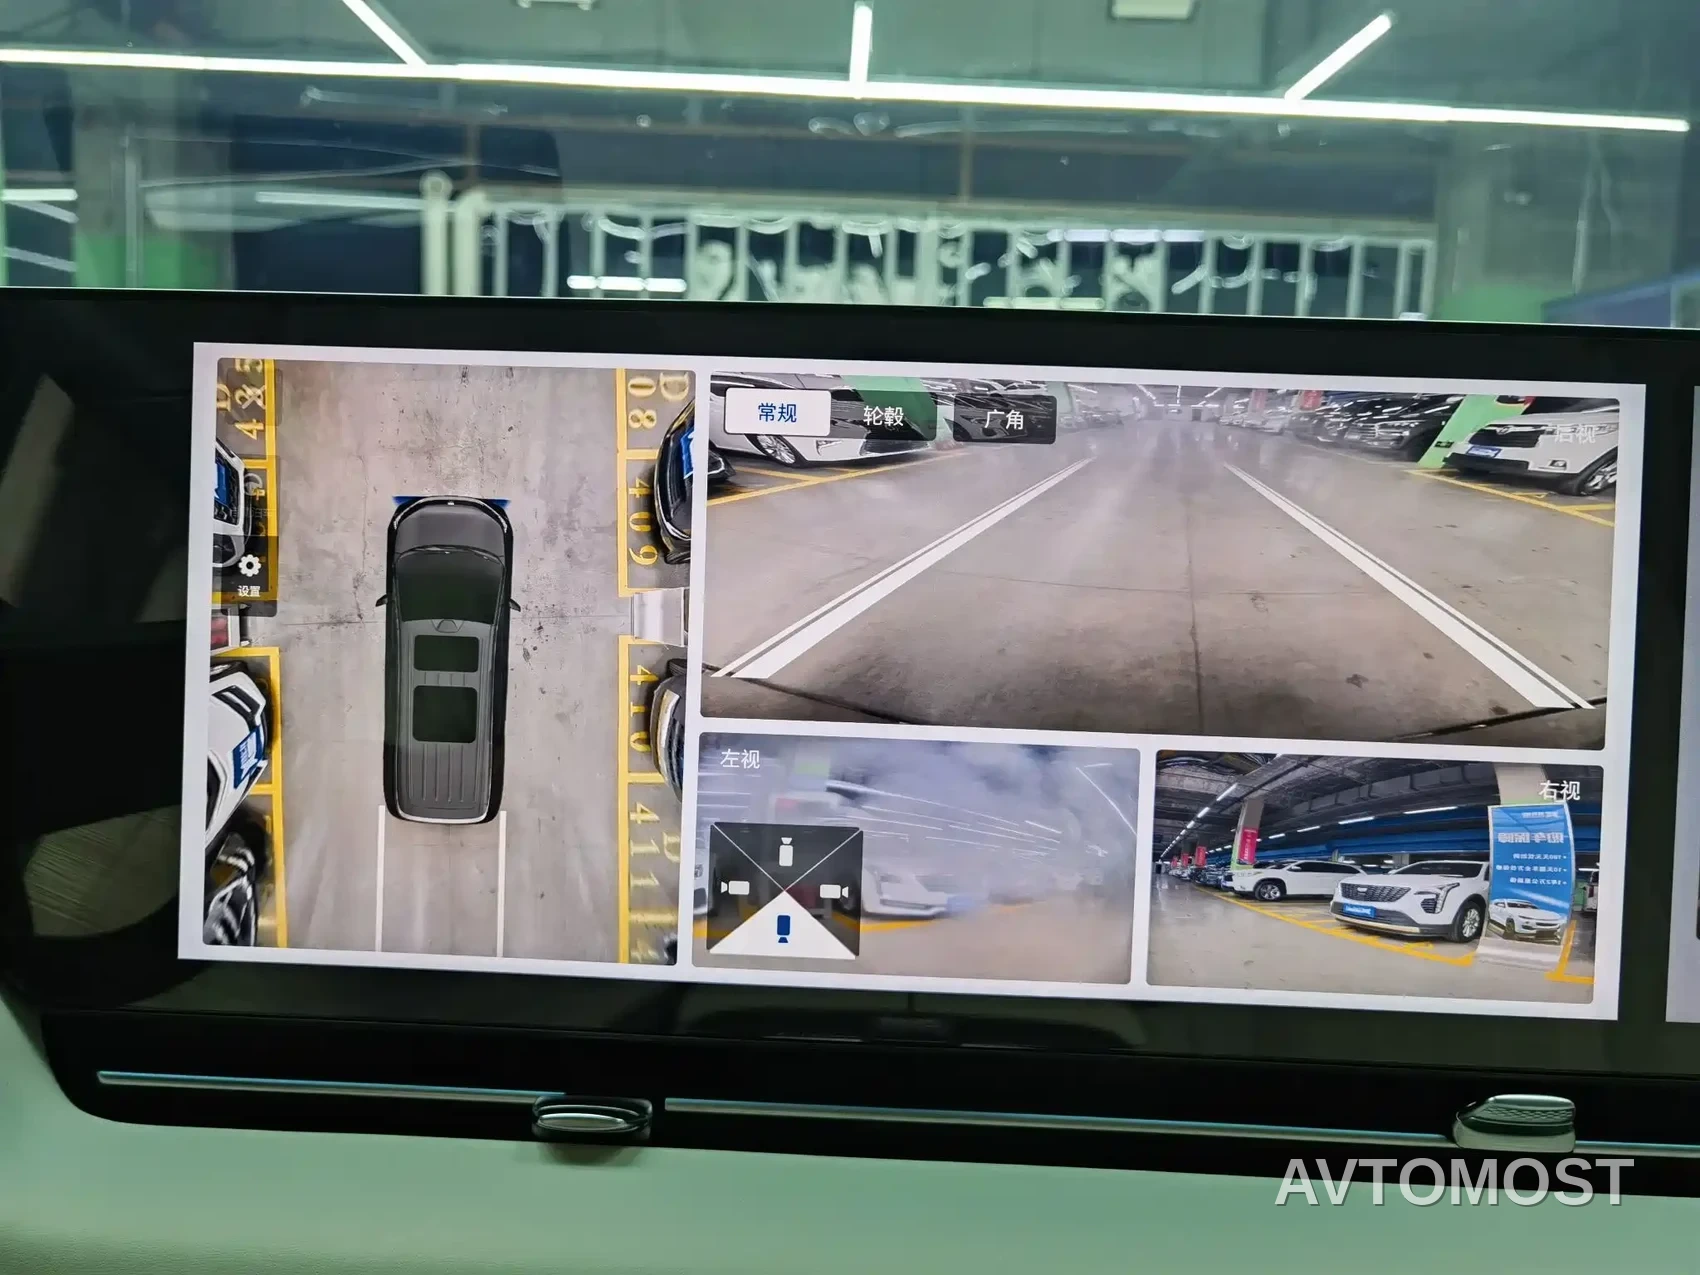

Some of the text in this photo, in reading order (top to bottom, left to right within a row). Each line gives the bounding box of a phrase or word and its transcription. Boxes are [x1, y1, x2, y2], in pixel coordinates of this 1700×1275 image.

[757, 403, 798, 424] 常规
[863, 405, 905, 427] 轮毂
[984, 408, 1025, 430] 广角
[628, 478, 658, 566] 409
[237, 585, 261, 598] 设置
[720, 749, 761, 769] 左视
[1538, 780, 1581, 801] 右视
[629, 802, 661, 888] 411
